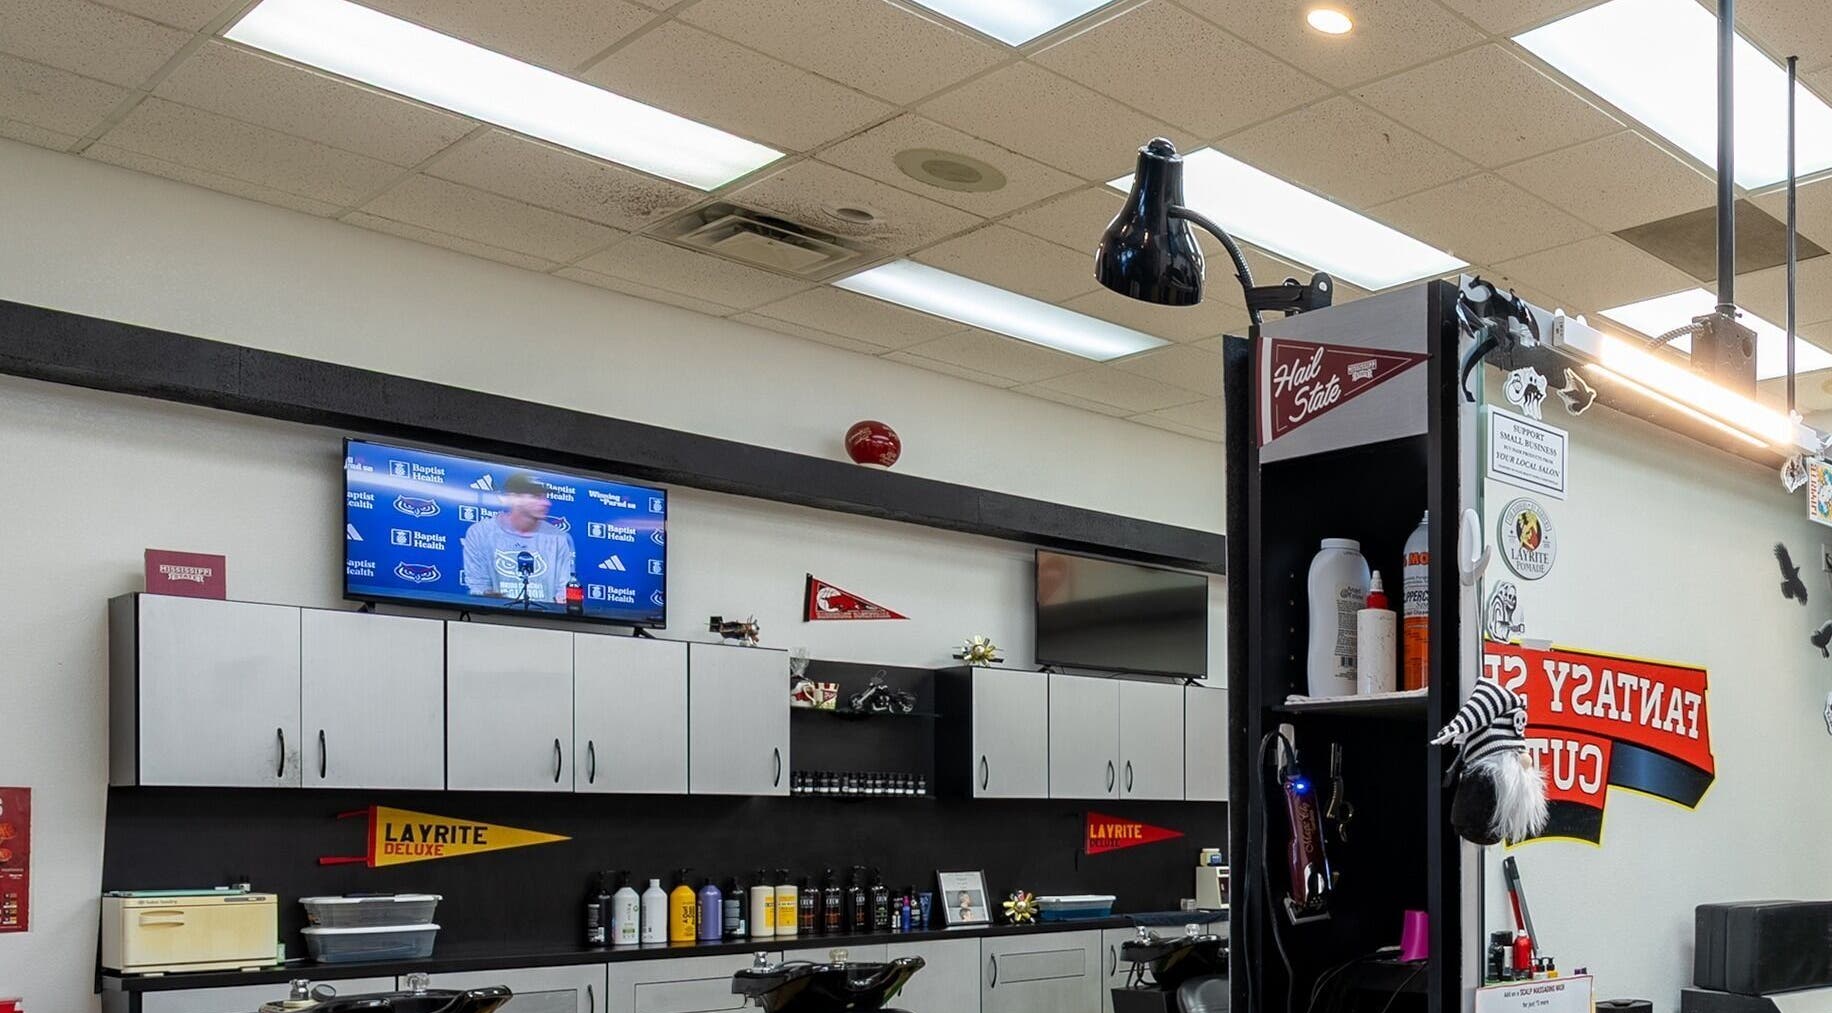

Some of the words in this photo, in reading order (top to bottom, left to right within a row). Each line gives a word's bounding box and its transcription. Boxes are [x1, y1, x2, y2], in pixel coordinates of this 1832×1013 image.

[1273, 346, 1325, 398] Hail
[1289, 374, 1342, 423] State
[1513, 424, 1544, 441] SUPPORT
[1500, 432, 1523, 446] SMALL
[1525, 440, 1558, 457] BUSINESS
[412, 463, 445, 476] Baptist
[1496, 451, 1515, 464] YOUR
[1516, 458, 1537, 471] LOCAL
[1539, 465, 1560, 478] SALON
[412, 472, 444, 483] Health
[347, 491, 375, 501] aptist
[348, 500, 373, 509] ealth
[607, 524, 636, 535] Baptist
[413, 531, 446, 542] Baptist
[607, 532, 635, 542] Health
[413, 540, 445, 550] Health
[1511, 548, 1549, 565] LAYRITE
[347, 560, 375, 568] aptist
[1516, 561, 1545, 573] POMADE
[607, 585, 636, 596] Baptist
[607, 594, 635, 603] Health
[385, 823, 488, 845] LAYRITE
[1090, 824, 1142, 839] LAYRITE
[384, 843, 444, 856] DELUXE
